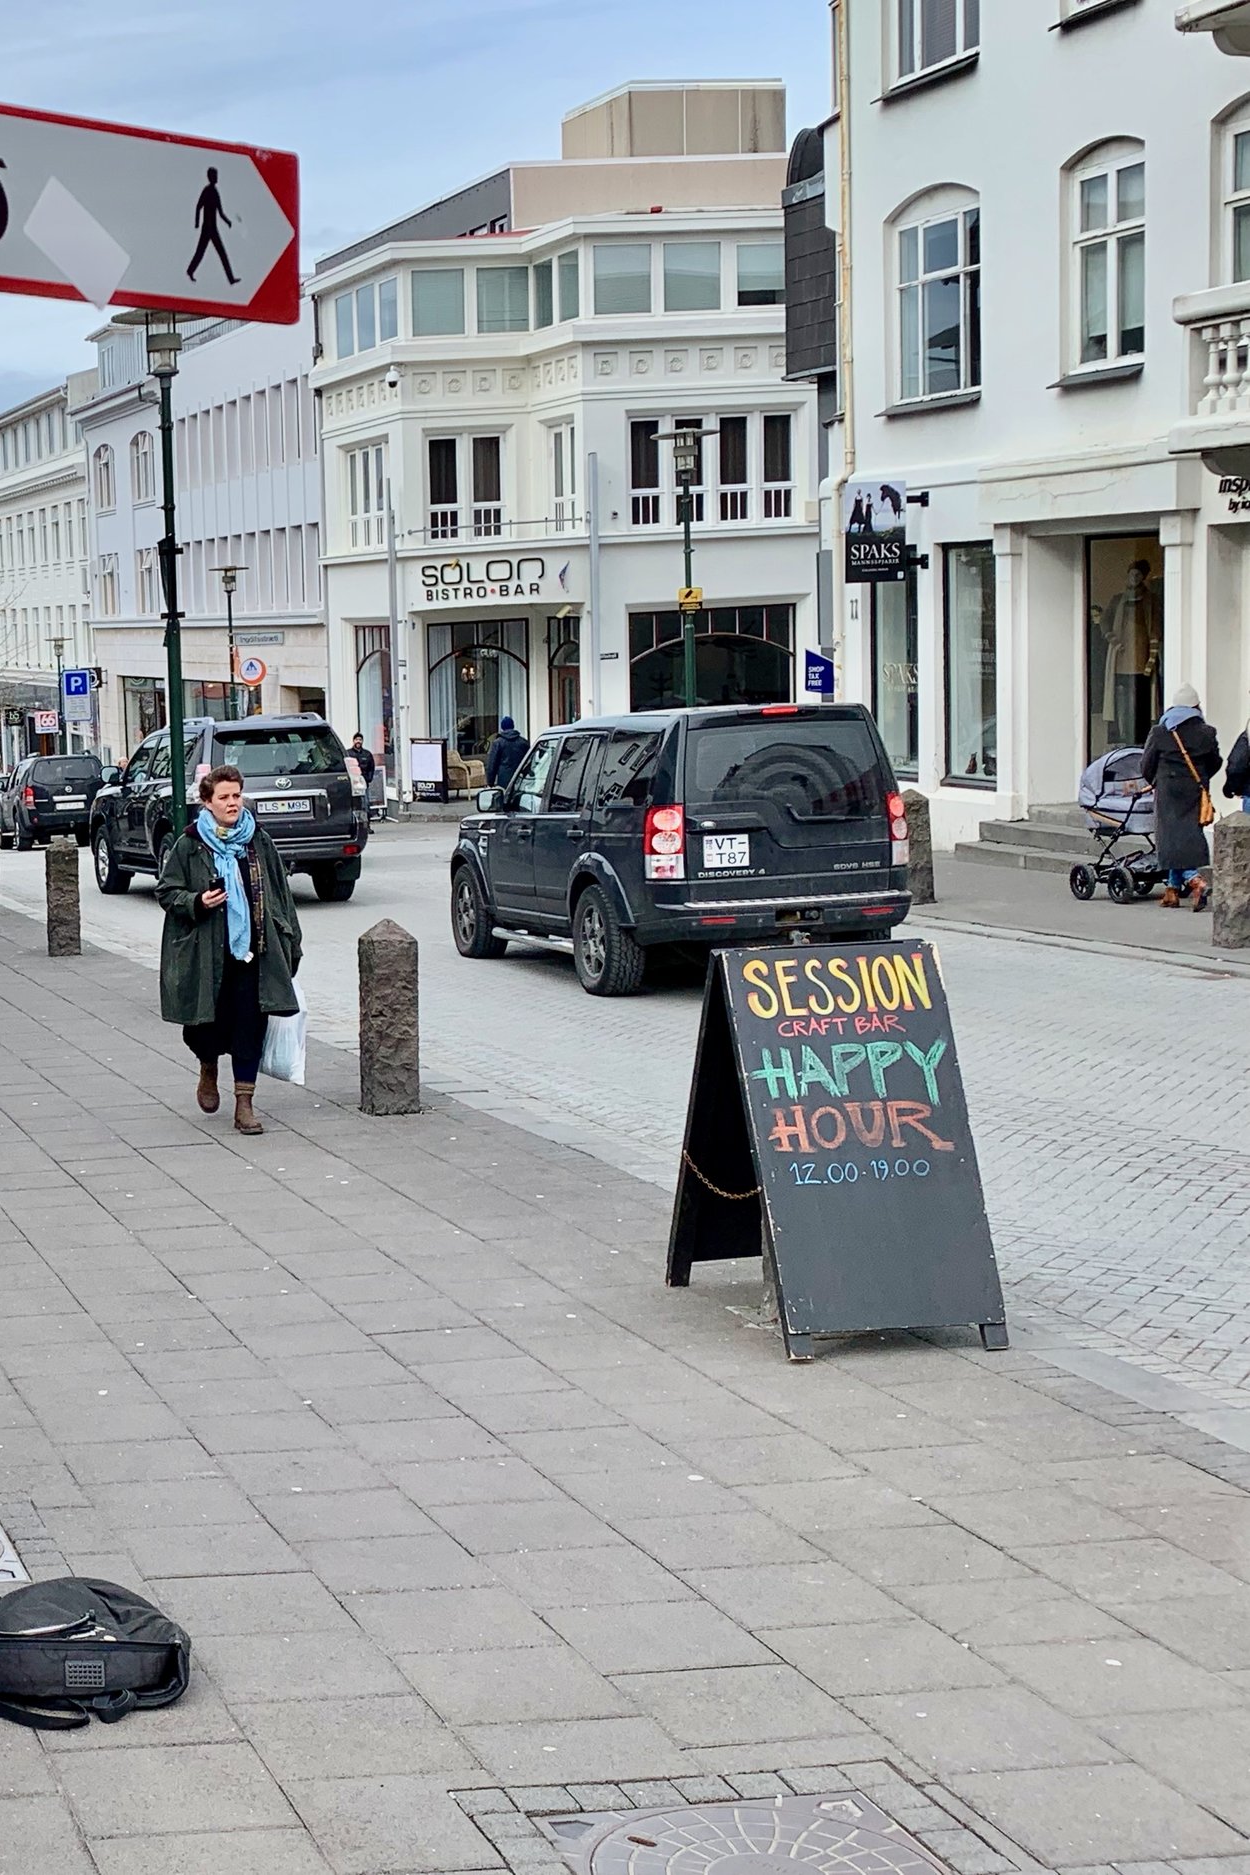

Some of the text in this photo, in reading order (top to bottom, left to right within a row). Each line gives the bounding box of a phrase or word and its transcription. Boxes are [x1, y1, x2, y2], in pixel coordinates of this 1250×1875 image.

[850, 542, 900, 560] SPAKS
[426, 582, 541, 601] BISTRO BAR
[70, 677, 83, 692] P
[265, 801, 308, 811] LS M95
[716, 852, 747, 864] T87
[698, 869, 754, 878] DISCOVERY
[743, 953, 932, 1019] SESSION
[778, 1013, 906, 1038] CRAFT BAR
[751, 1038, 947, 1106] HAPPY
[768, 1100, 955, 1153] HOUR
